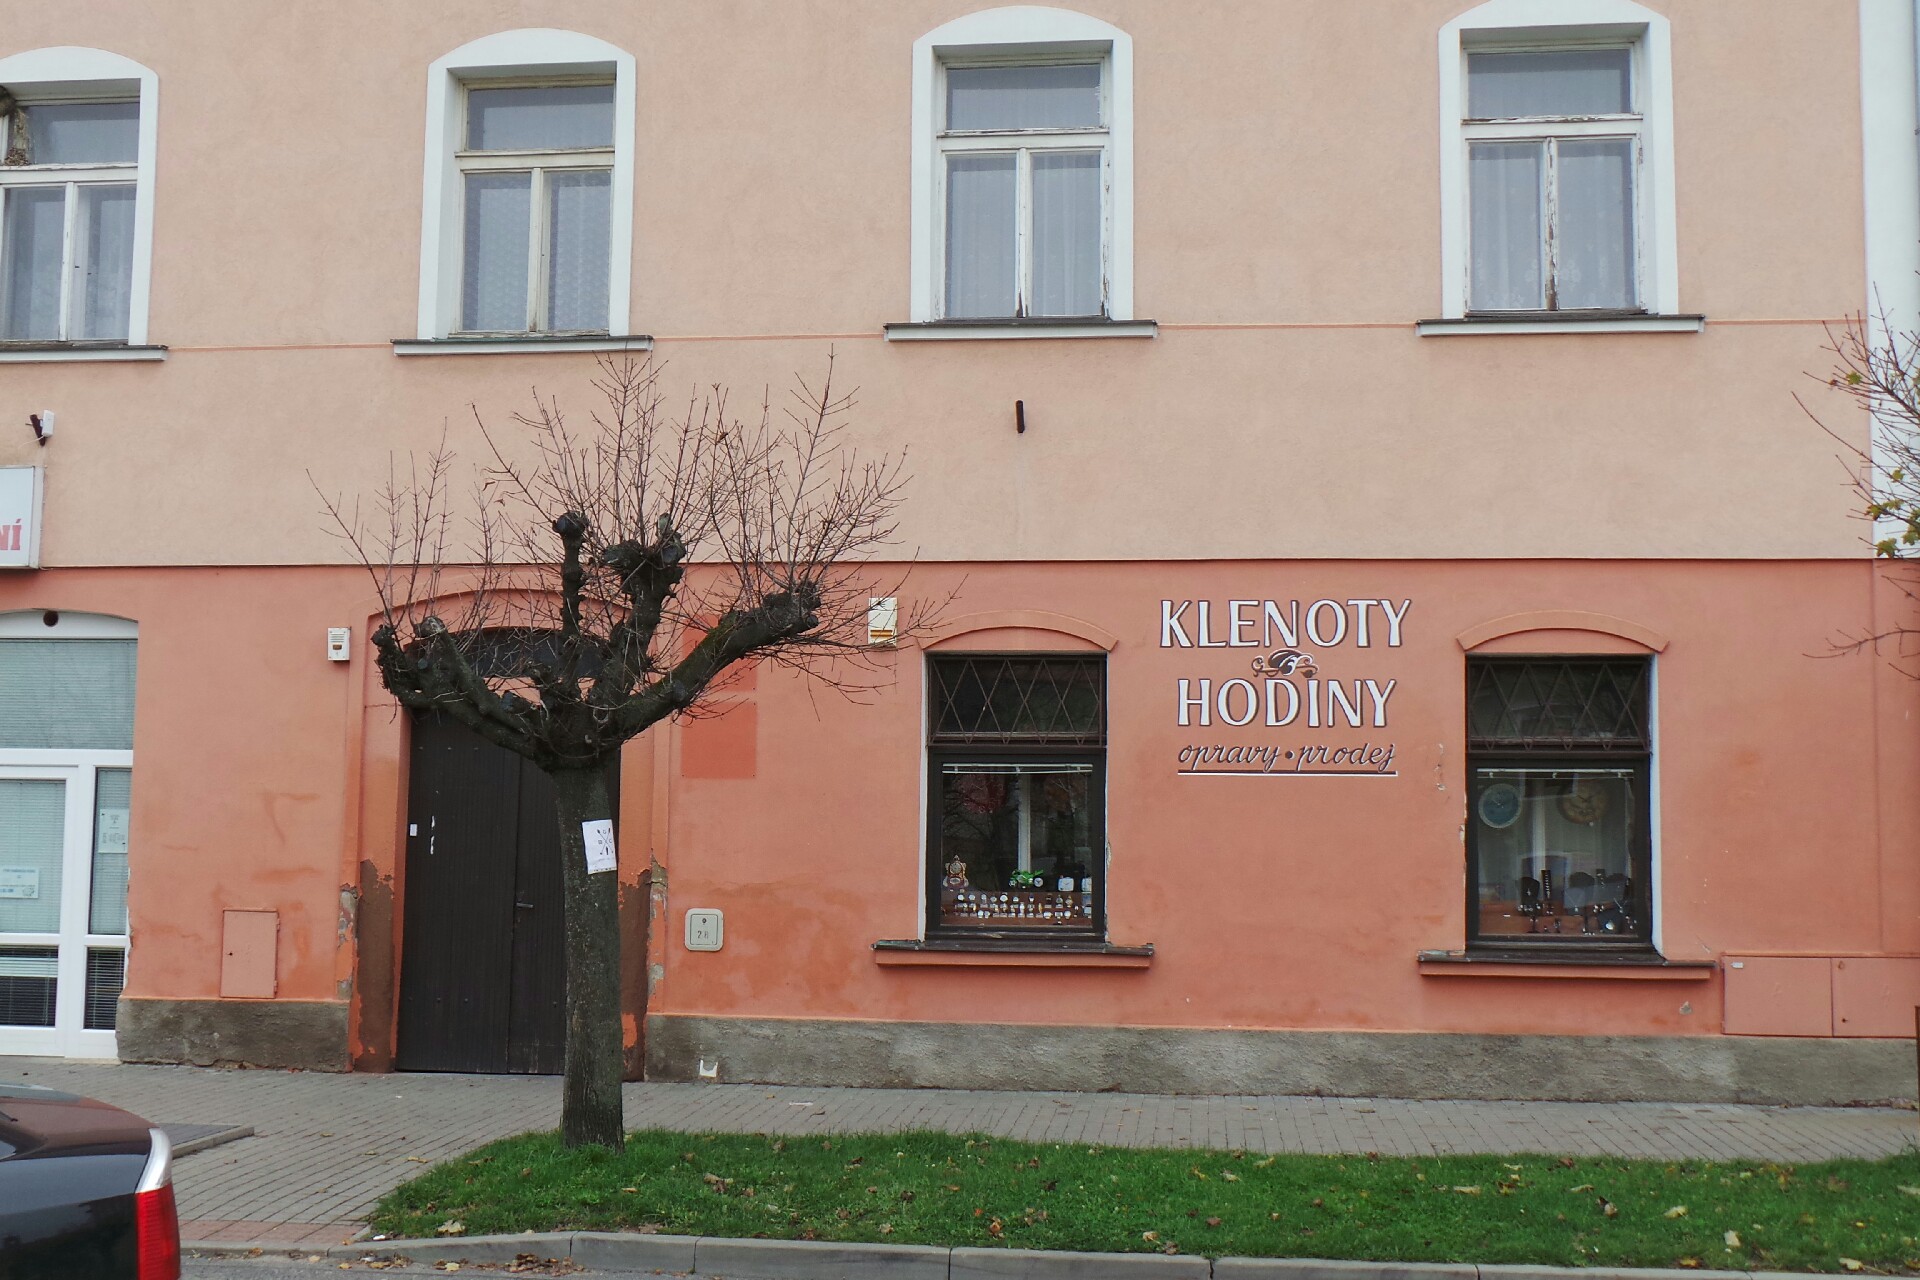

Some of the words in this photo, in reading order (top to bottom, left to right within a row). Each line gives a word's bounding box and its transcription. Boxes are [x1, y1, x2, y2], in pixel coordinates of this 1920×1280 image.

[1160, 599, 1412, 648] KLENOTY
[1177, 678, 1397, 728] HODINY
[1177, 743, 1280, 772] opravy
[1296, 743, 1396, 772] prodej
